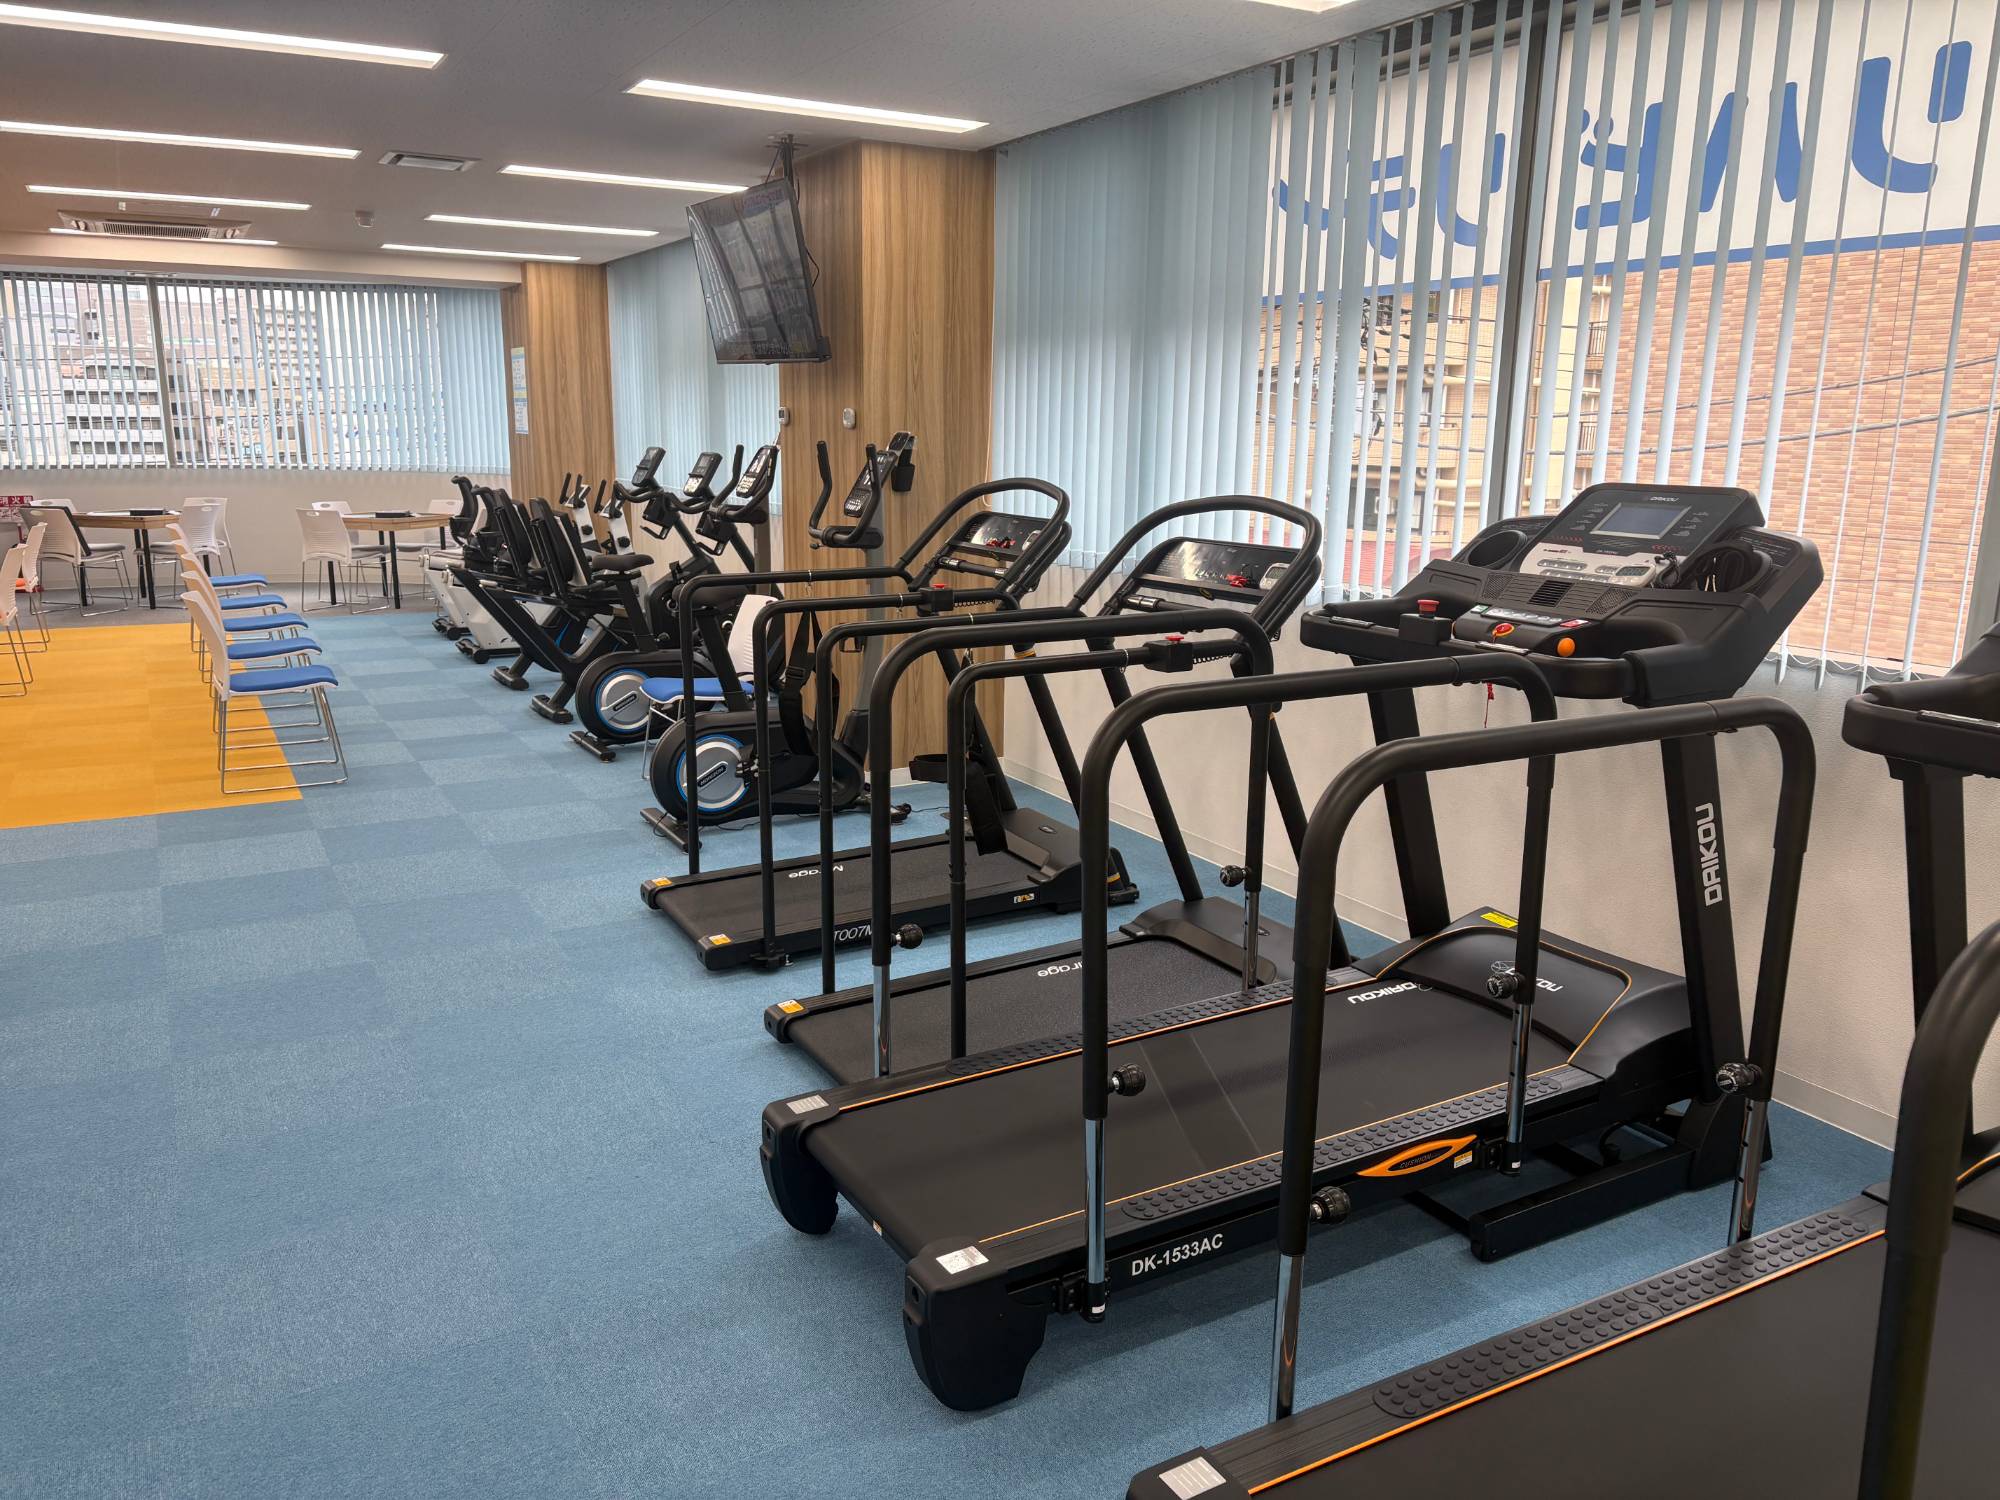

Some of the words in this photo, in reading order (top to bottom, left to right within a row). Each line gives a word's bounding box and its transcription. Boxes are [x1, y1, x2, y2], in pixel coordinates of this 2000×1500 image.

[1695, 802, 1723, 907] DAIKOU
[788, 864, 844, 879] Mage
[1347, 981, 1418, 1004] DAIKOU
[1400, 1152, 1432, 1169] CUSHION
[1132, 1233, 1224, 1277] DK-1533AC
